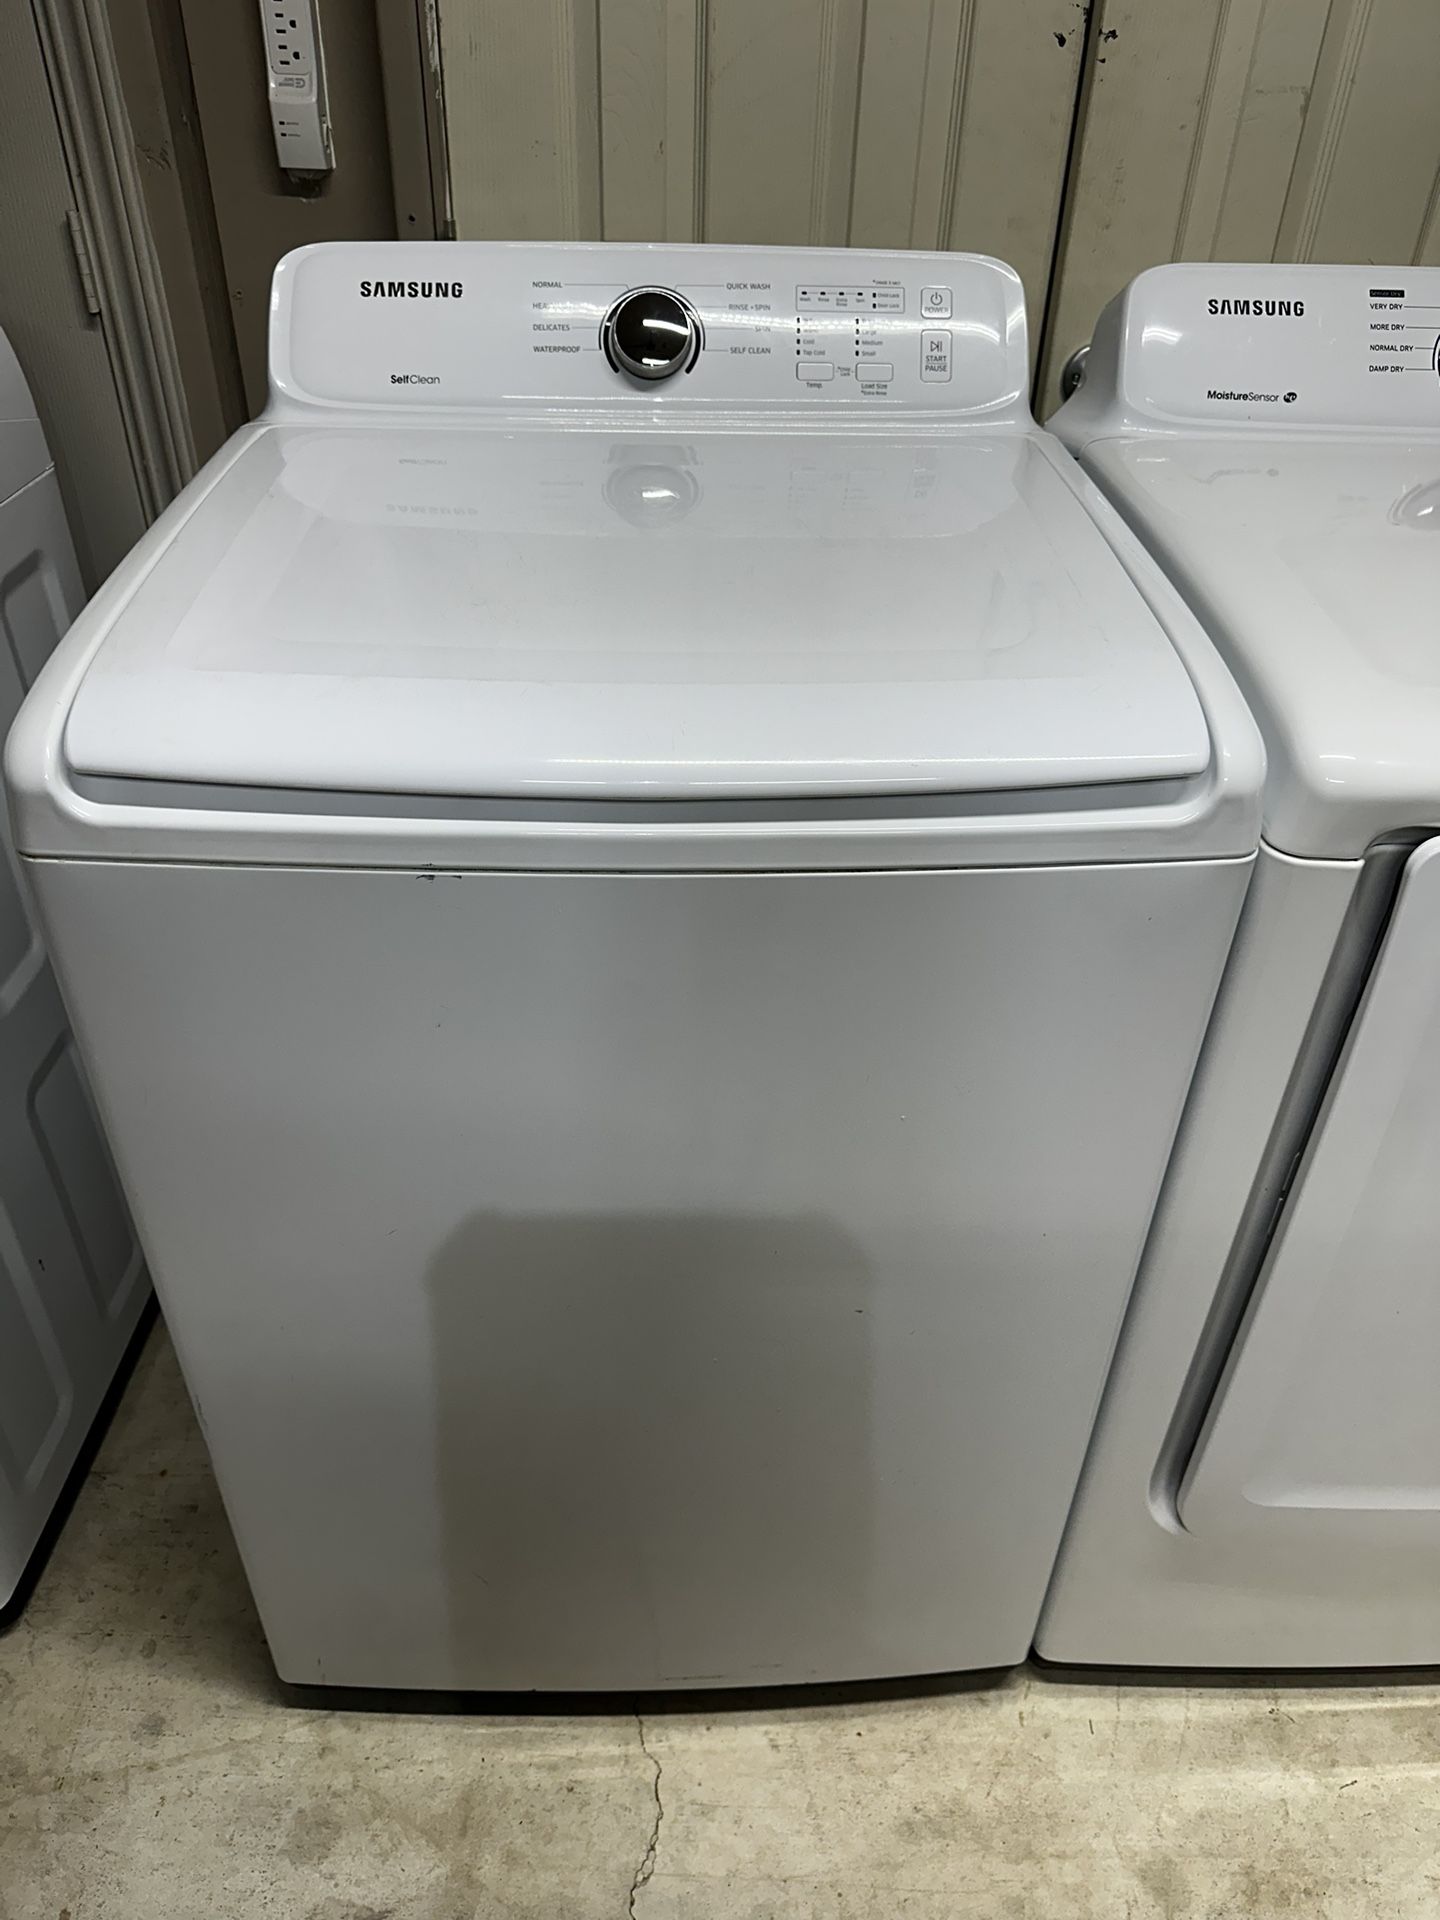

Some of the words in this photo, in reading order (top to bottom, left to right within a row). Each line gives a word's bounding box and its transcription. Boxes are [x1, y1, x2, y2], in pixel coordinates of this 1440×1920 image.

[360, 281, 463, 298] SAMSUNG
[728, 303, 748, 311] RINSE
[1208, 299, 1304, 316] SAMSUNG
[532, 323, 570, 331] DELICATES
[533, 345, 581, 353] WATERPROOF
[730, 346, 746, 354] SELF
[748, 346, 771, 354] CLEAN
[1369, 344, 1398, 352] NORMAL
[1399, 344, 1414, 352] DRY
[1390, 365, 1404, 373] DRY
[390, 374, 441, 384] SelfClean
[1207, 390, 1280, 402] MoistureSensor
